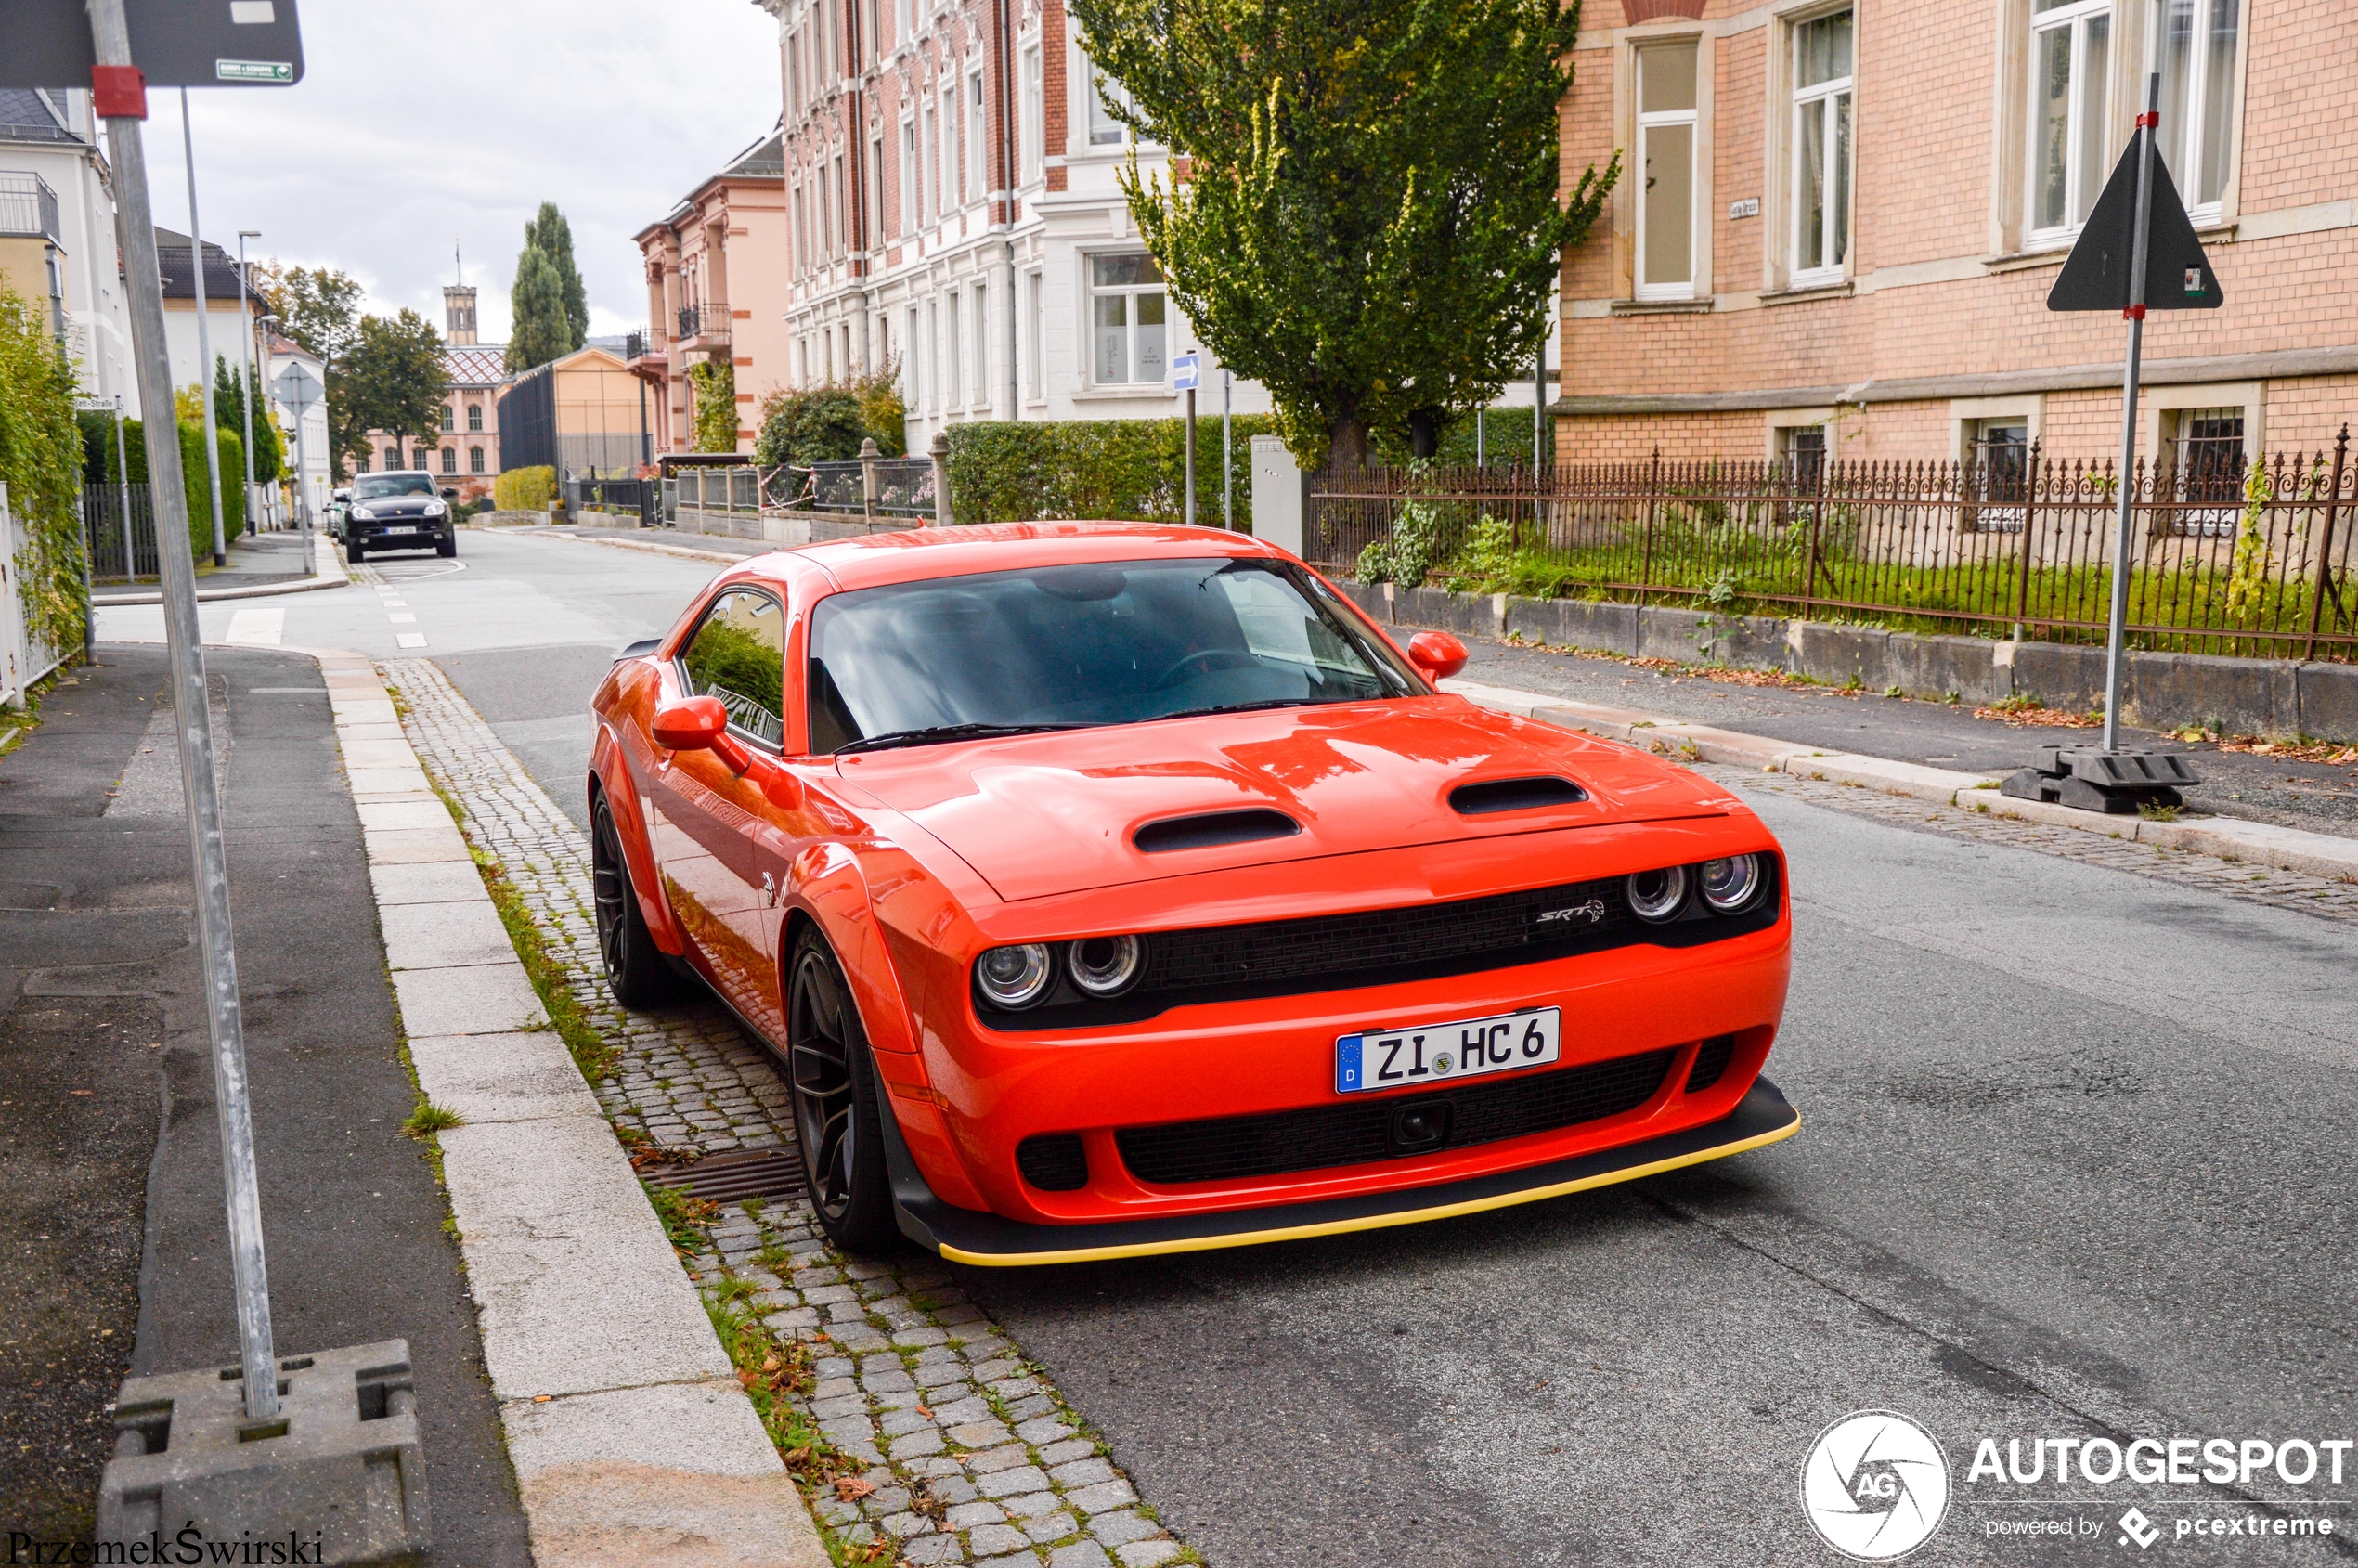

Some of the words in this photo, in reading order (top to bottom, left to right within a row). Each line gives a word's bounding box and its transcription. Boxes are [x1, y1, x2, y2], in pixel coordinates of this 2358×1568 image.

[1536, 905, 1591, 923] SRT
[1378, 1035, 1429, 1081] ZI
[1460, 1023, 1512, 1069] HC
[1522, 1018, 1545, 1058] 6
[1346, 1069, 1355, 1082] D
